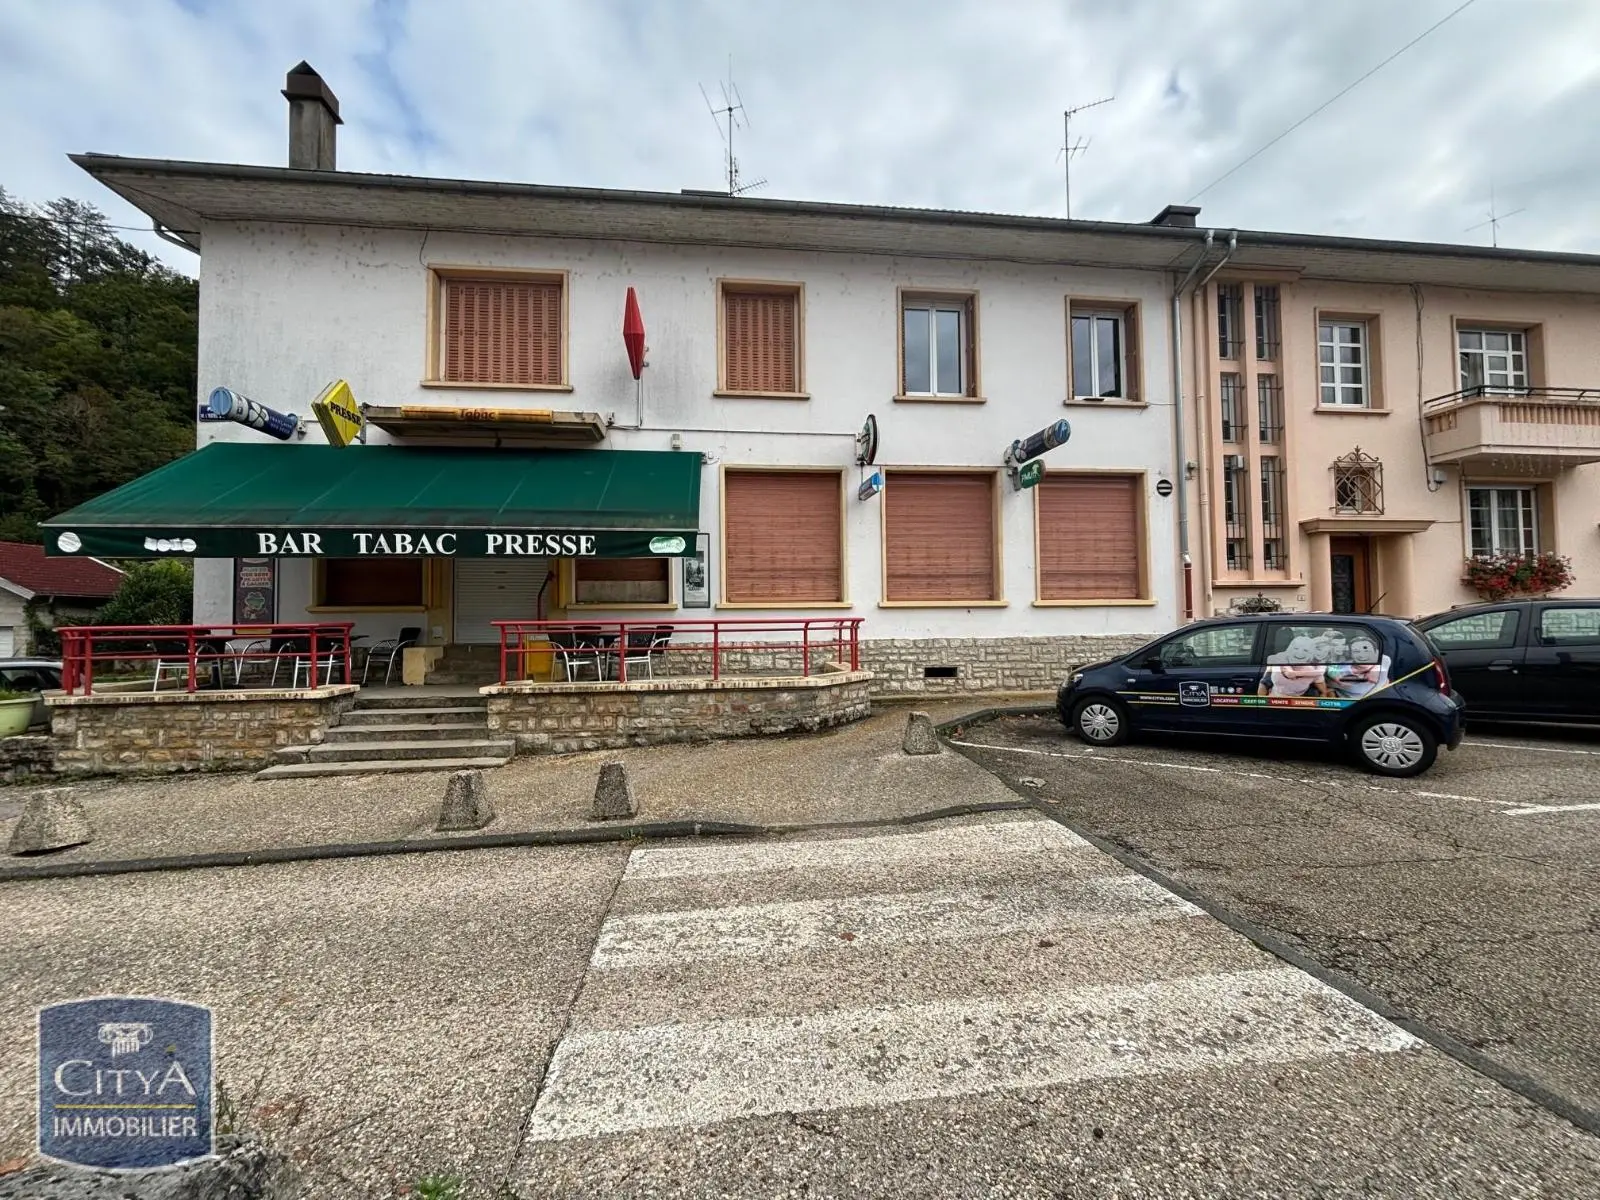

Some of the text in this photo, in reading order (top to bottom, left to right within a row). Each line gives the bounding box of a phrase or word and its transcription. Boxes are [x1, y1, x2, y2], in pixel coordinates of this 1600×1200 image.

[330, 401, 362, 426] PRESSE
[459, 408, 496, 420] Tabac
[256, 532, 597, 556] BAR TABAC PRESSE
